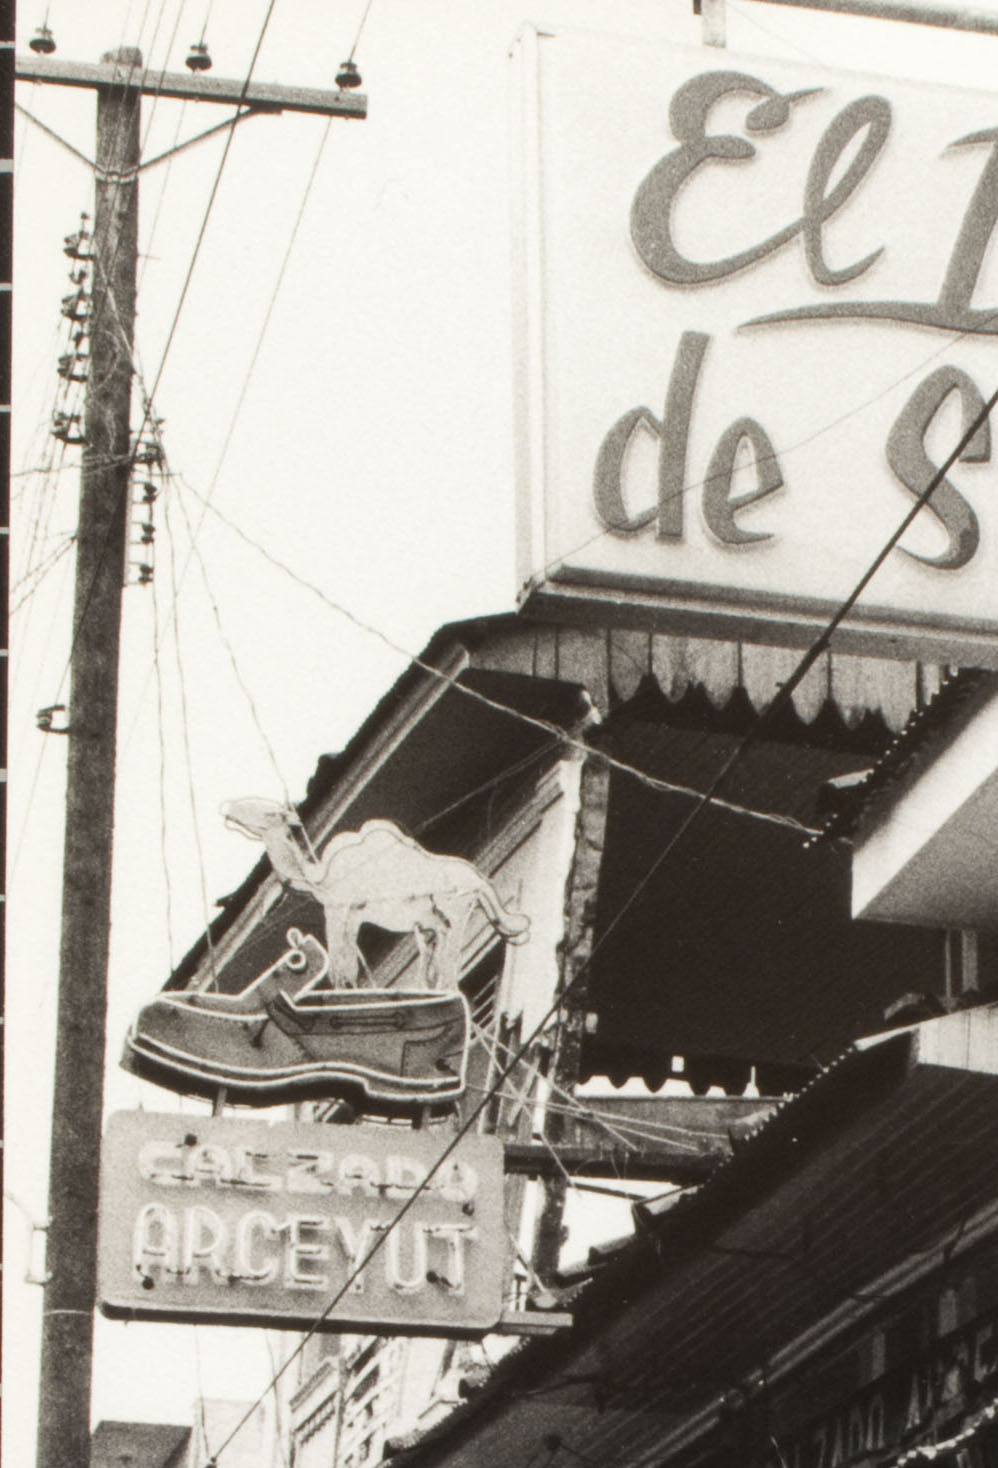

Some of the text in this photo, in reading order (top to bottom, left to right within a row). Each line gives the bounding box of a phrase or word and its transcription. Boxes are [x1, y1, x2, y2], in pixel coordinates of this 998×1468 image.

[629, 69, 893, 287] El
[593, 330, 784, 546] de
[138, 1143, 479, 1202] CALZADO
[133, 1205, 477, 1295] ARCEYUT
